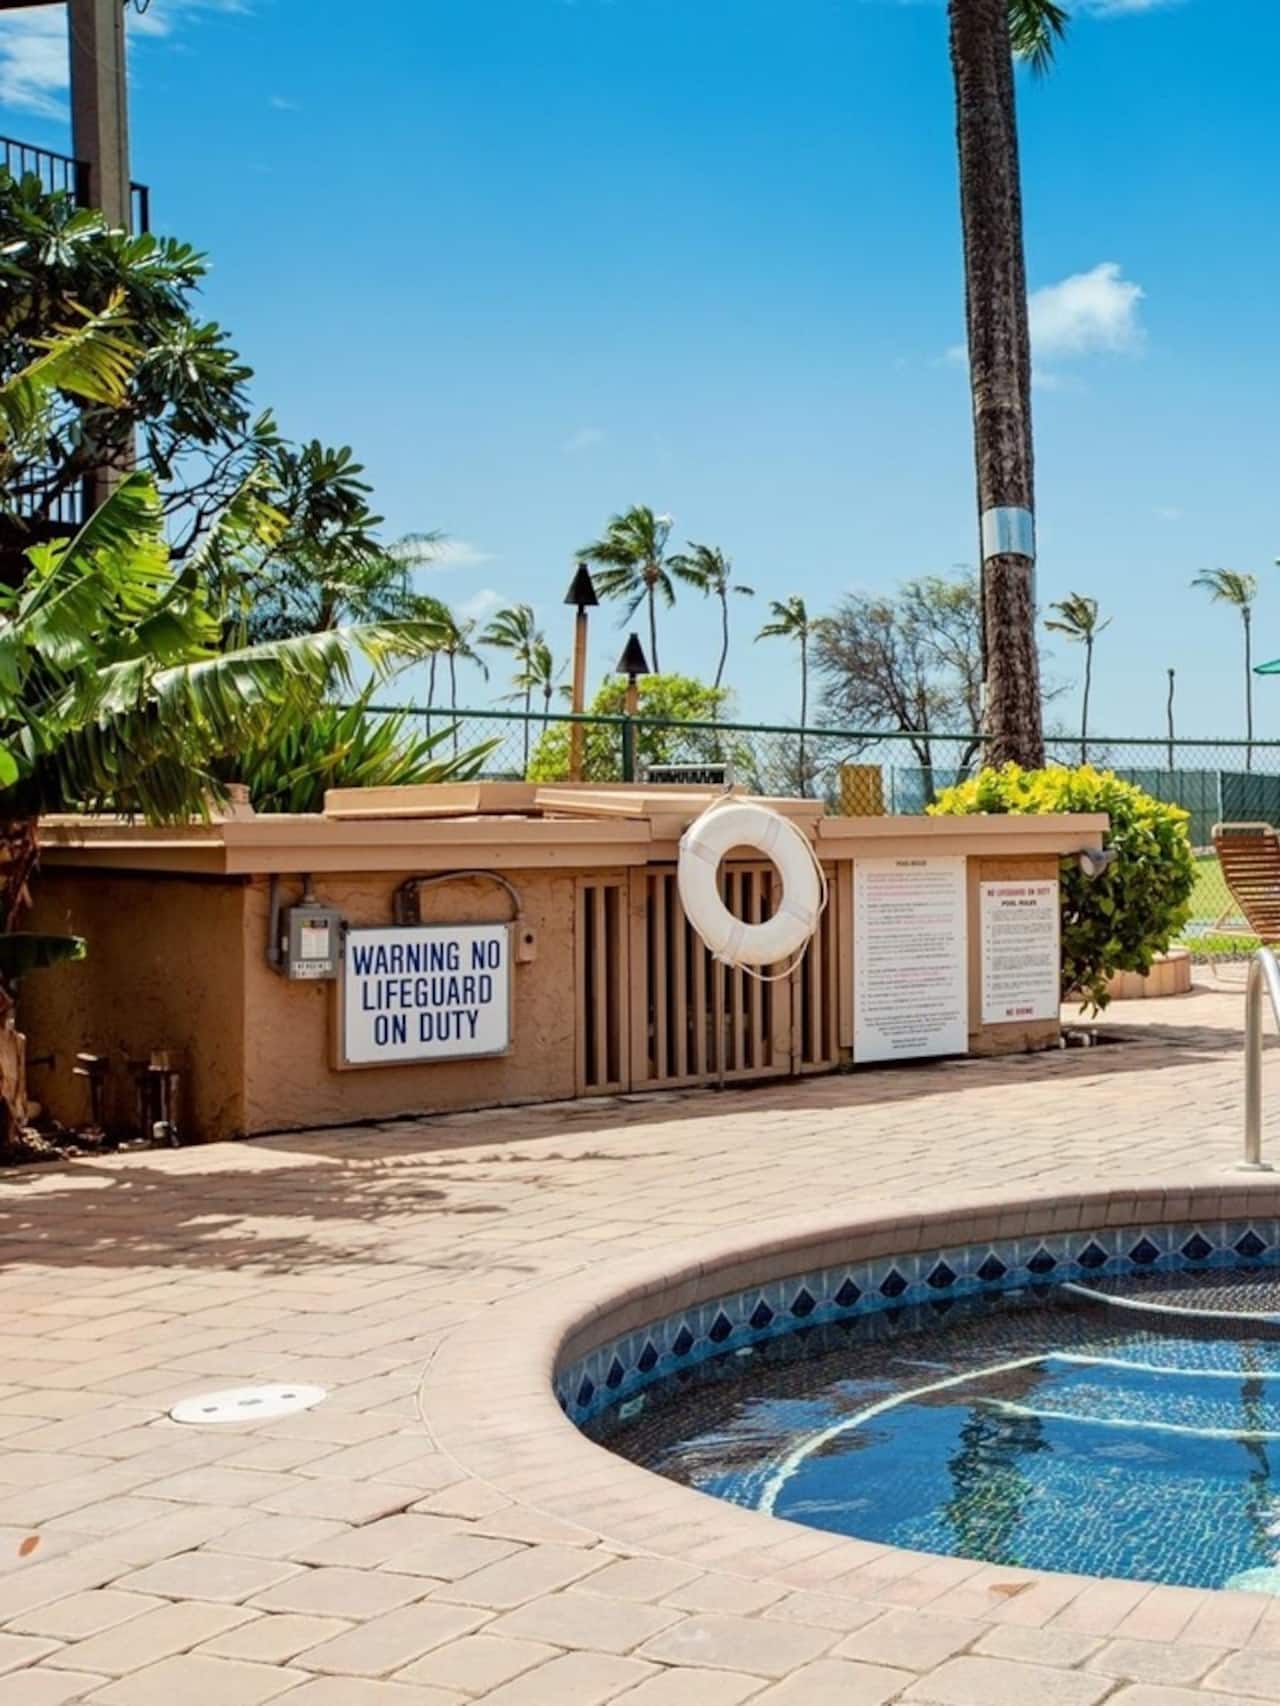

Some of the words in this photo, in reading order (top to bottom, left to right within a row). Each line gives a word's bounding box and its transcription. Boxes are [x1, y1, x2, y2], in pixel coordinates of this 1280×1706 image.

[352, 942, 459, 976] WARNING
[472, 940, 501, 970] NO
[362, 974, 492, 1010] LIFEGUARD
[374, 1014, 407, 1046] ON
[419, 1009, 479, 1042] DUTY
